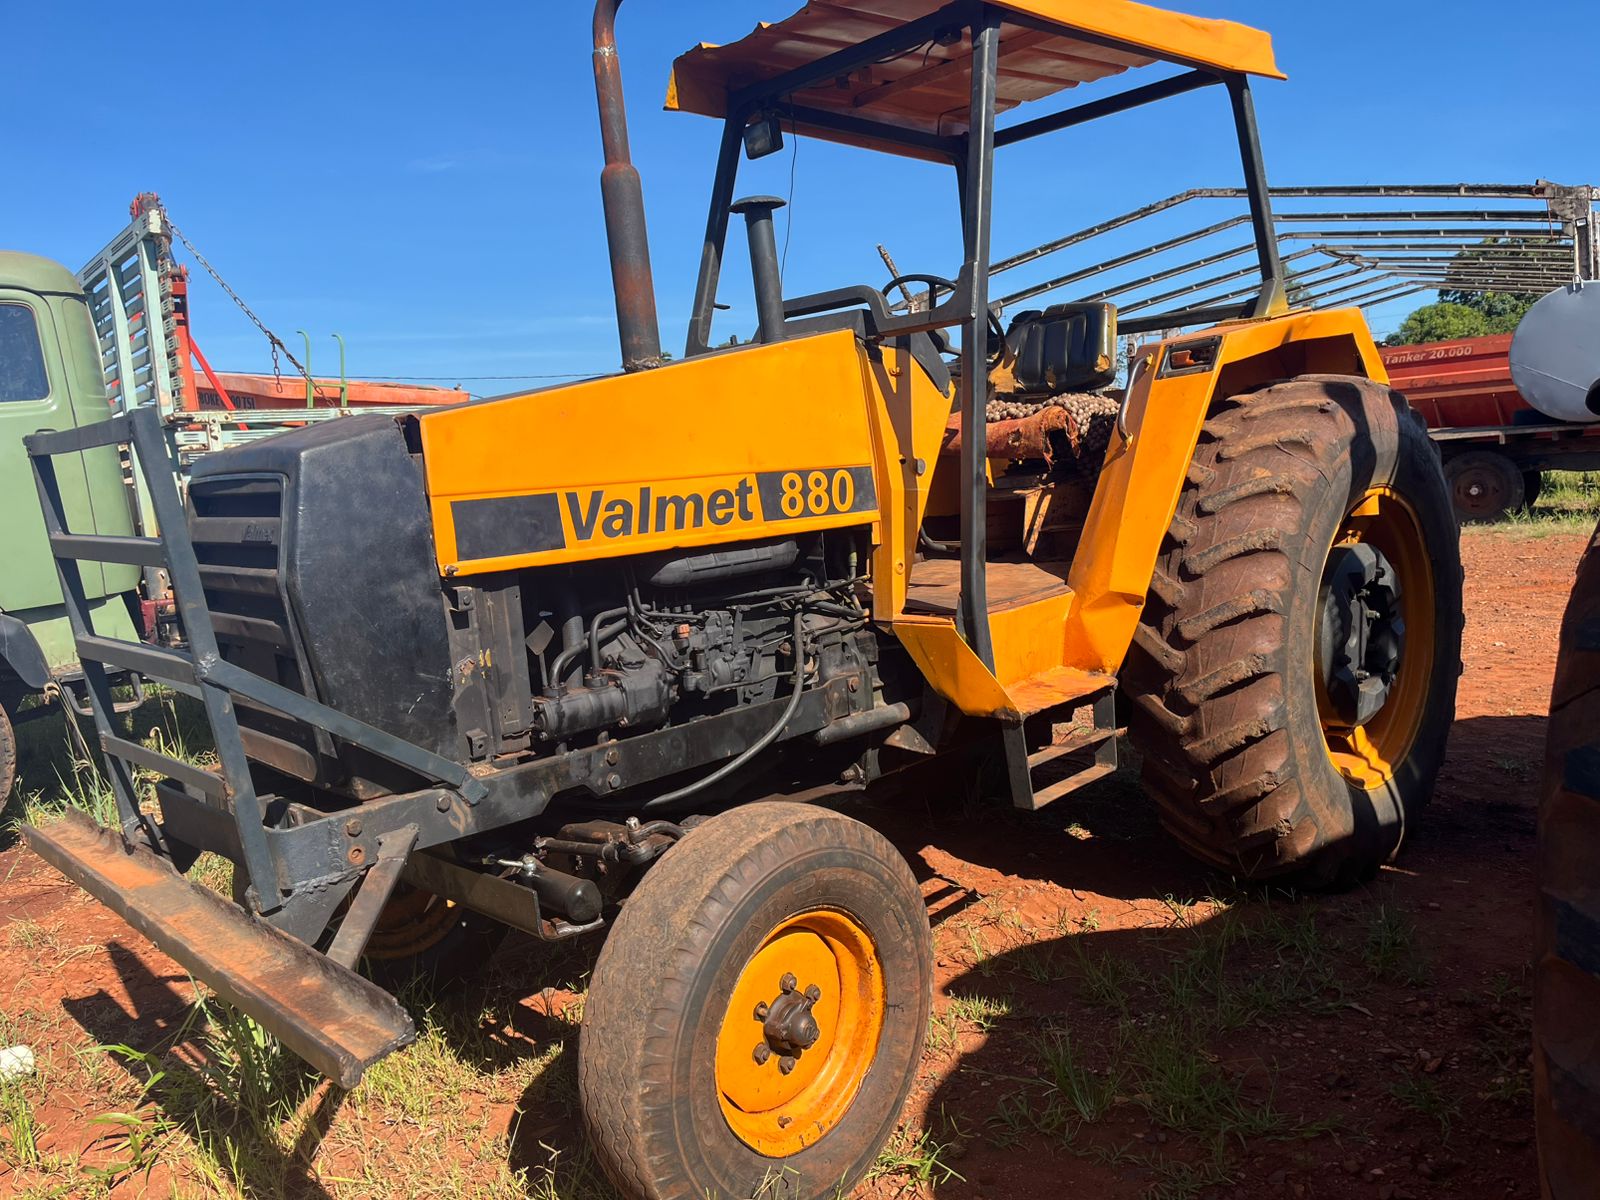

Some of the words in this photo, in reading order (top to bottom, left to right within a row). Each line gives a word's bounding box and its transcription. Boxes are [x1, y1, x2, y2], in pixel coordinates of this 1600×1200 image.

[1385, 351, 1426, 365] Tanker
[1428, 346, 1472, 360] 20.000
[565, 477, 753, 541] Valmet
[780, 468, 855, 518] 880
